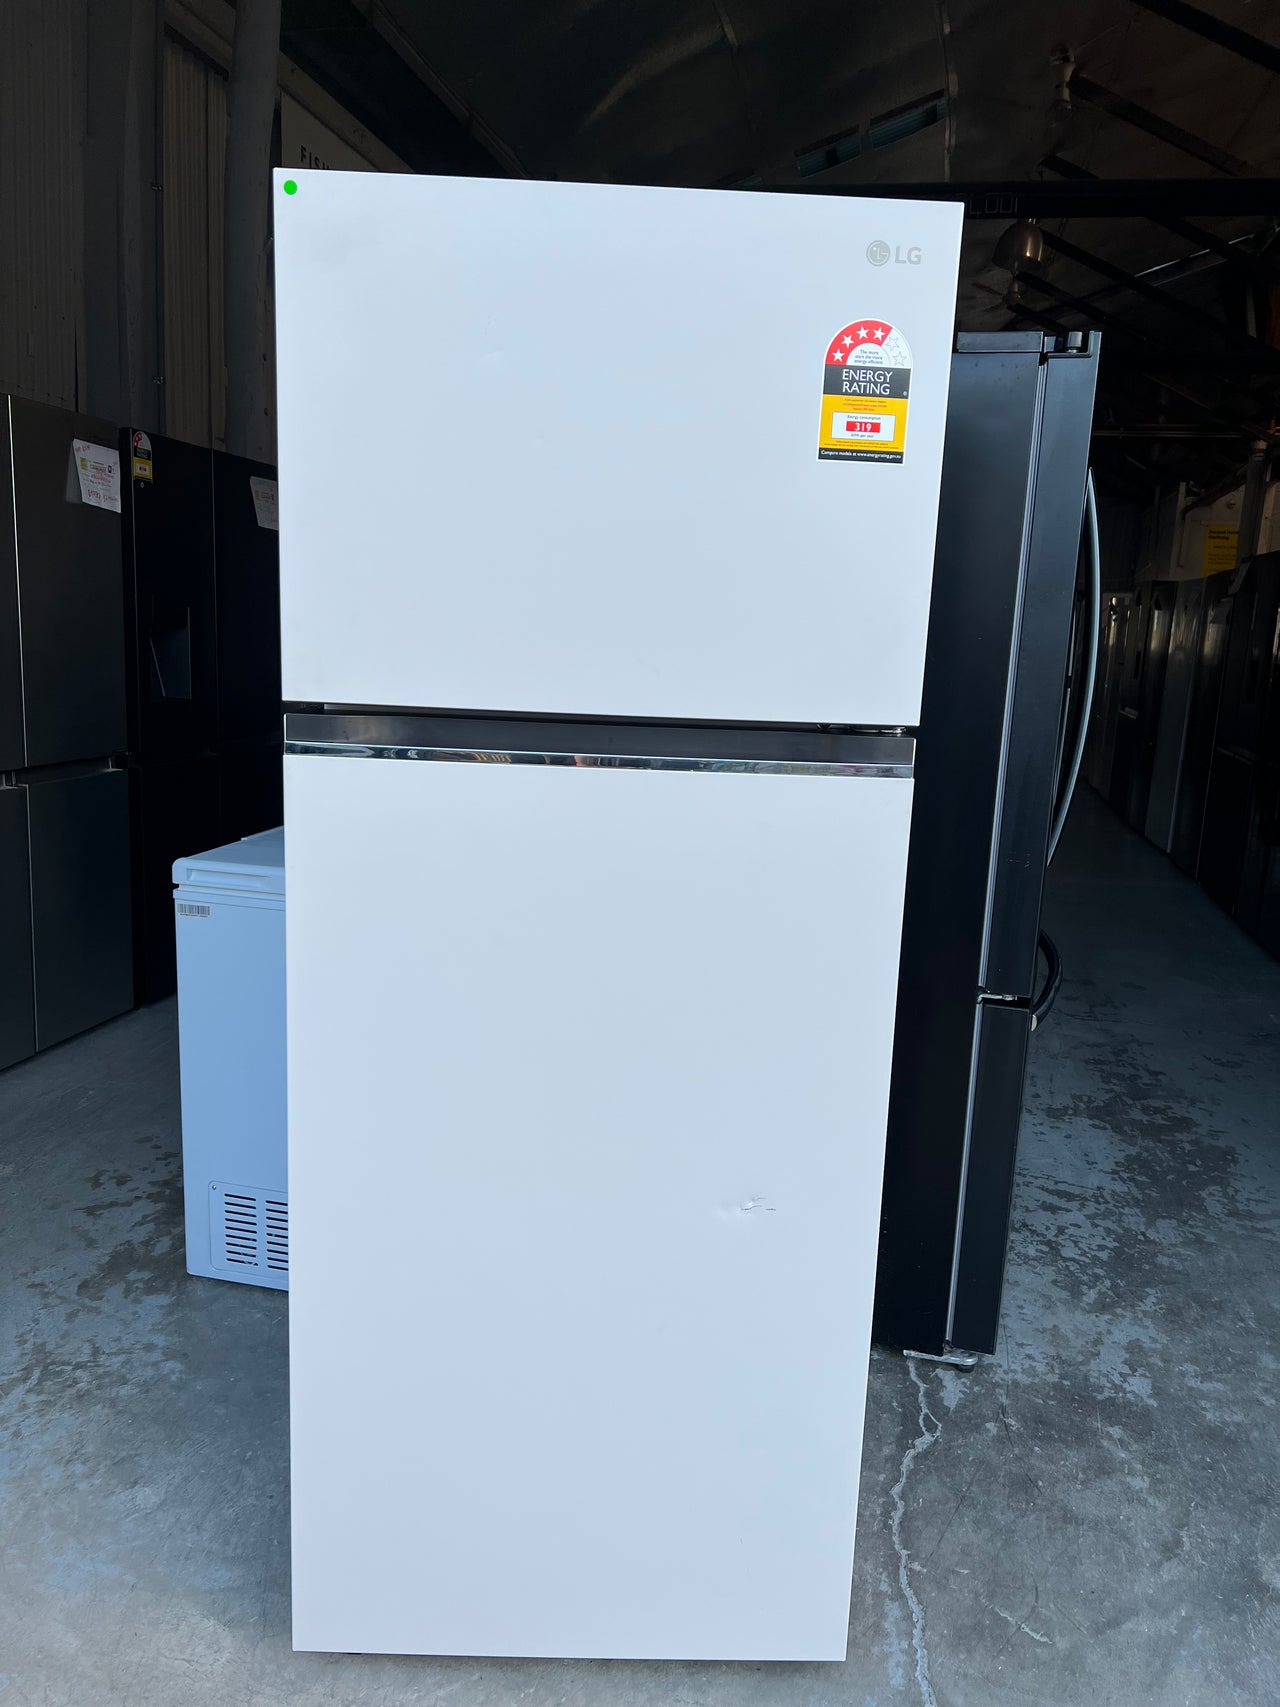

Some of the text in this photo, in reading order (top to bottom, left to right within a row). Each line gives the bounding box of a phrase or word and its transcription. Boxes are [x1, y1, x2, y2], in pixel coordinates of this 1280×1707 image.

[895, 245, 922, 265] LG
[842, 369, 893, 382] ENERGY
[842, 381, 891, 395] RATING
[854, 422, 872, 432] 319
